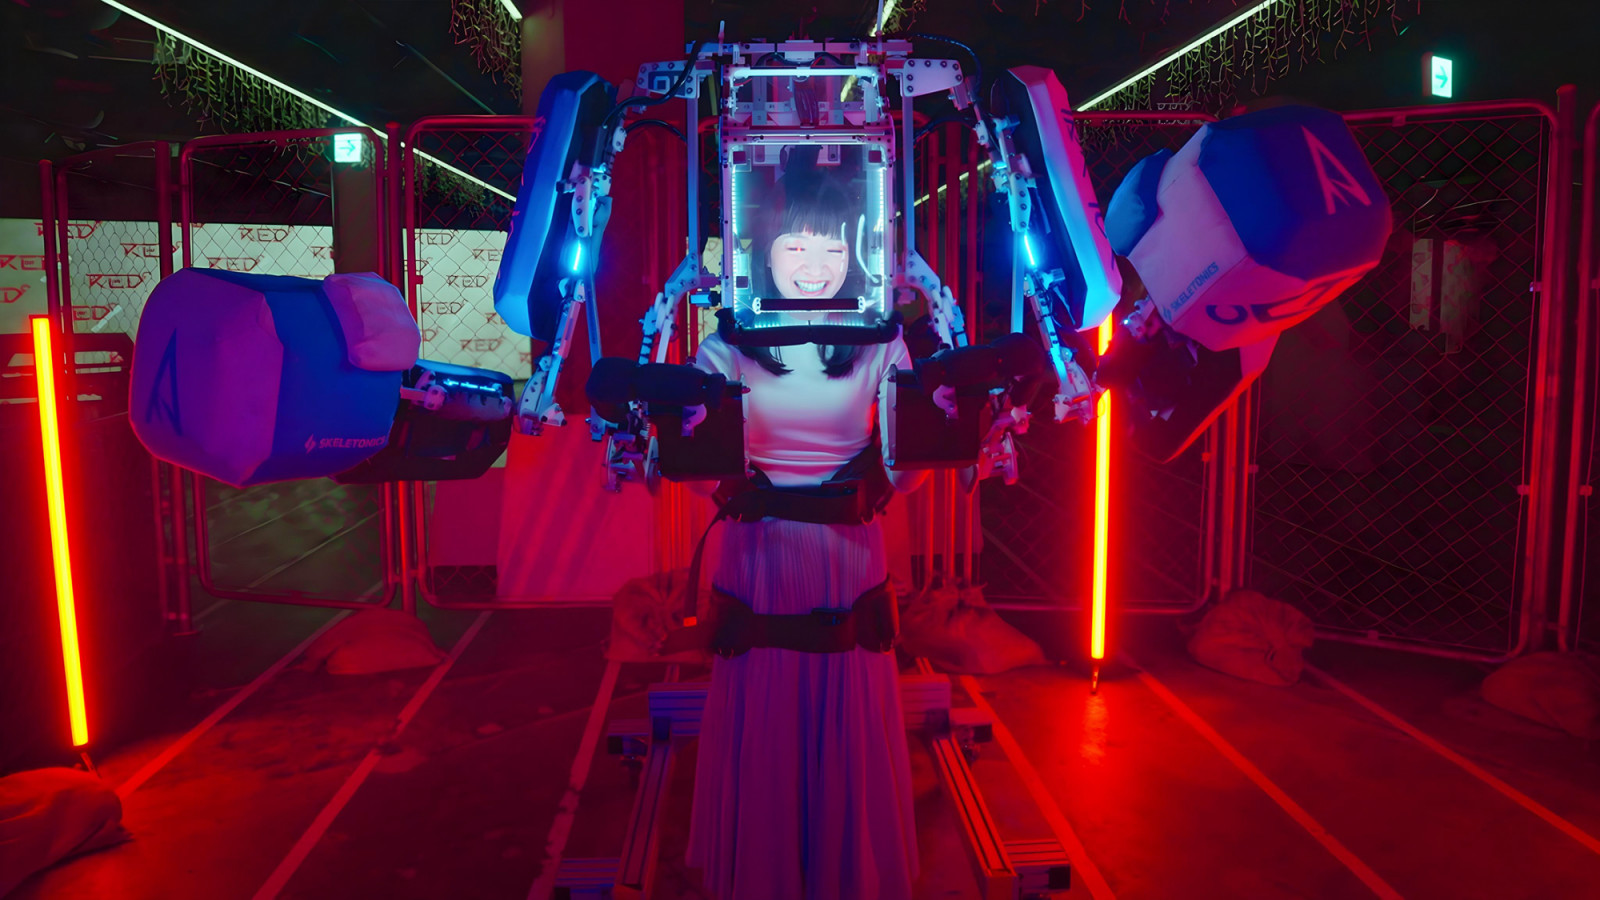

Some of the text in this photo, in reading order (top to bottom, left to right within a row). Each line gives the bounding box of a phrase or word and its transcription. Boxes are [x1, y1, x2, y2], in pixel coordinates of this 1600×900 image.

[0, 254, 46, 271] RE
[472, 248, 504, 262] RE
[86, 271, 152, 289] RED
[446, 272, 494, 288] RED
